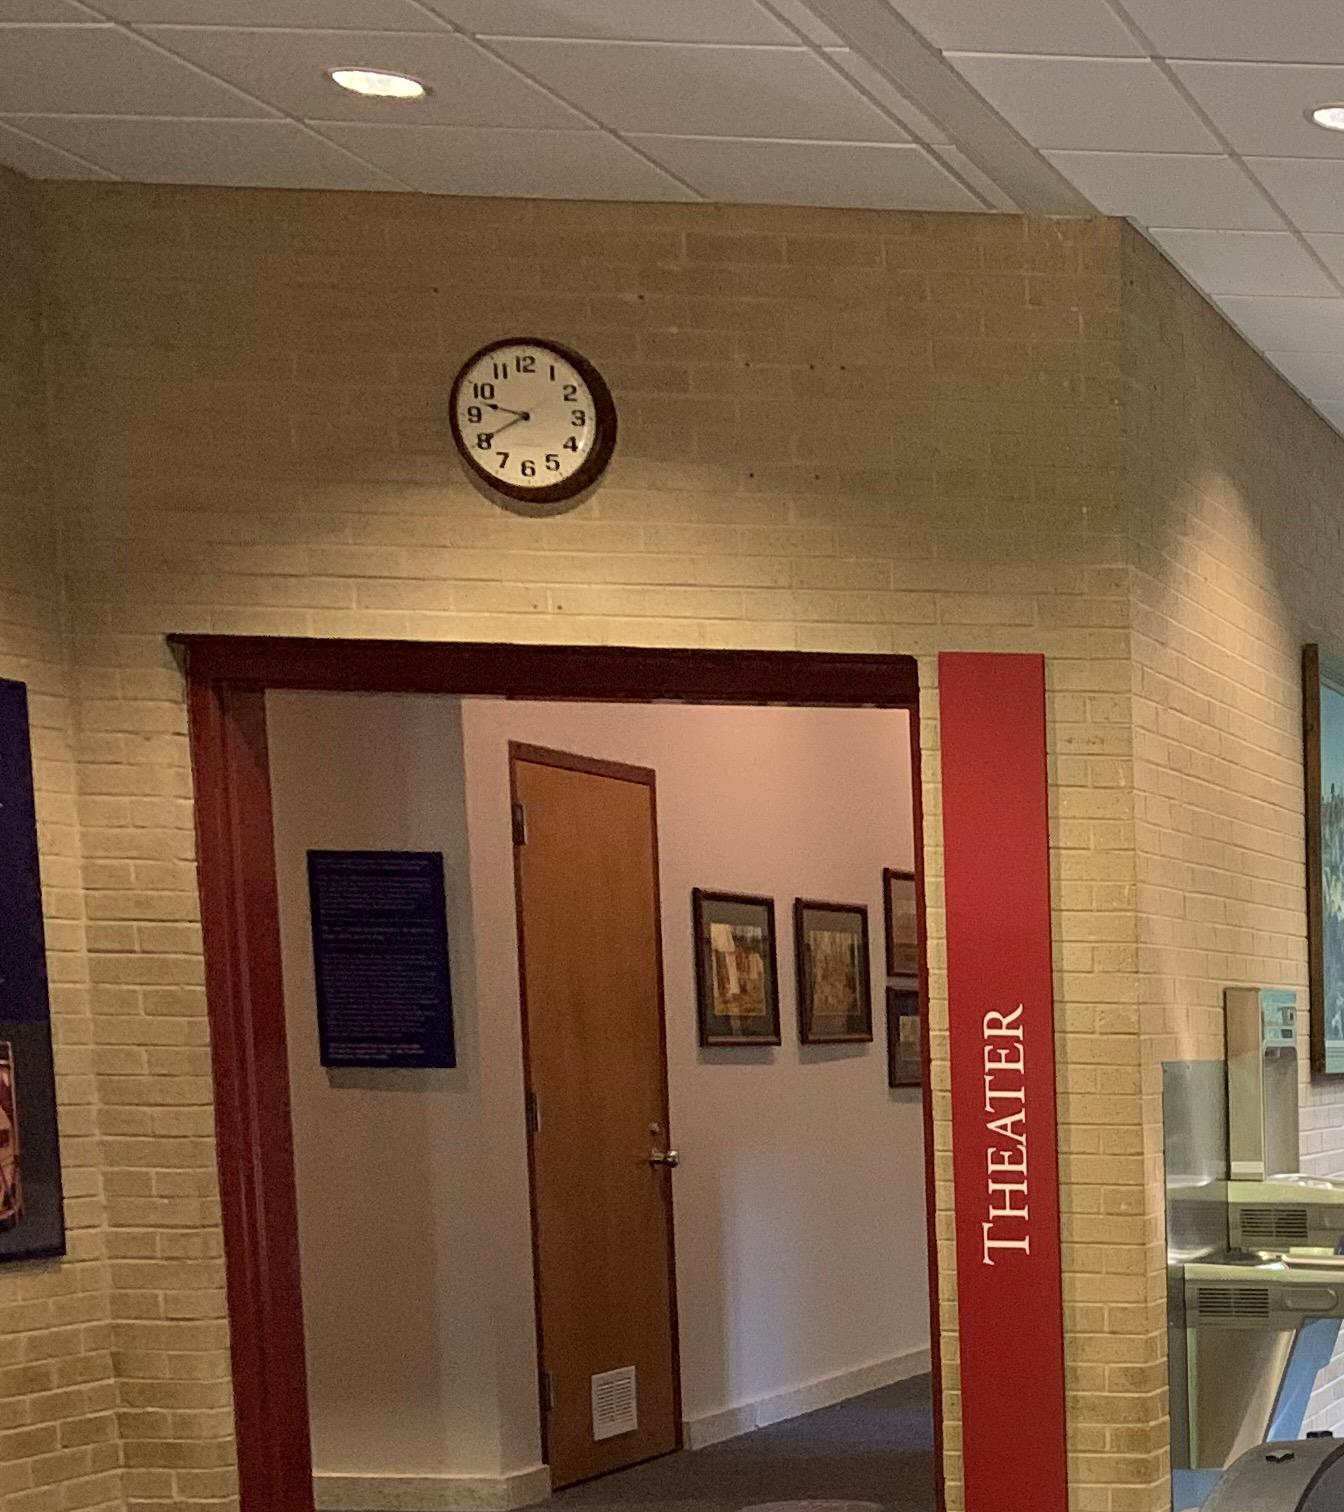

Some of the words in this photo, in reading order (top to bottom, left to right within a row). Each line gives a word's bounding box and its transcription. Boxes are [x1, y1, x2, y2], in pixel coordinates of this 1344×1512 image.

[493, 363, 508, 379] 11
[515, 355, 536, 373] 12
[549, 365, 555, 381] 1
[473, 383, 495, 400] 10
[562, 384, 577, 402] 2
[467, 406, 482, 423] 9
[571, 409, 586, 427] 3
[476, 432, 493, 450] 8
[563, 436, 578, 453] 4
[496, 452, 510, 469] 7
[520, 460, 536, 477] 6
[545, 454, 560, 471] 5
[982, 1003, 1030, 1265] THEATER
